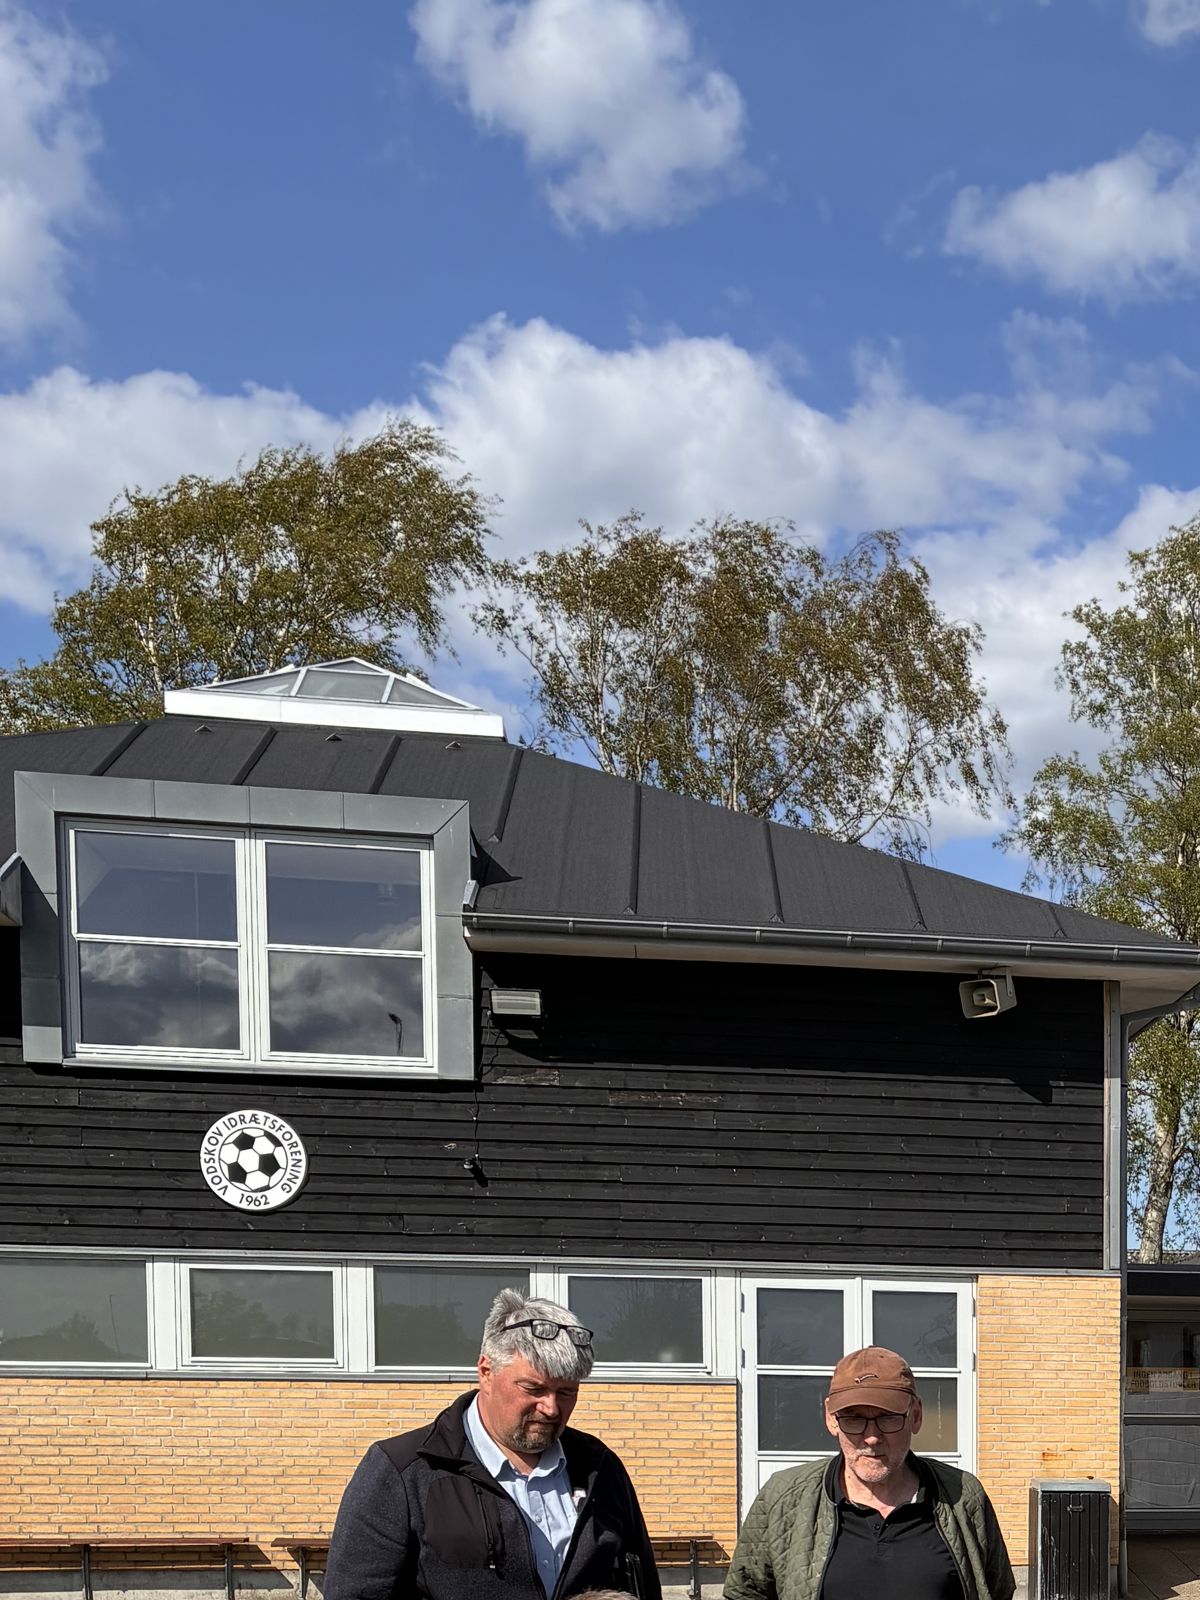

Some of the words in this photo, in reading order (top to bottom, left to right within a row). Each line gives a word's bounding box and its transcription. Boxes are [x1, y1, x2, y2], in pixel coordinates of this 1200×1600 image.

[203, 1127, 229, 1196] VODSKOV
[222, 1112, 303, 1194] IDRÆTSFORENING
[238, 1192, 271, 1208] 1962
